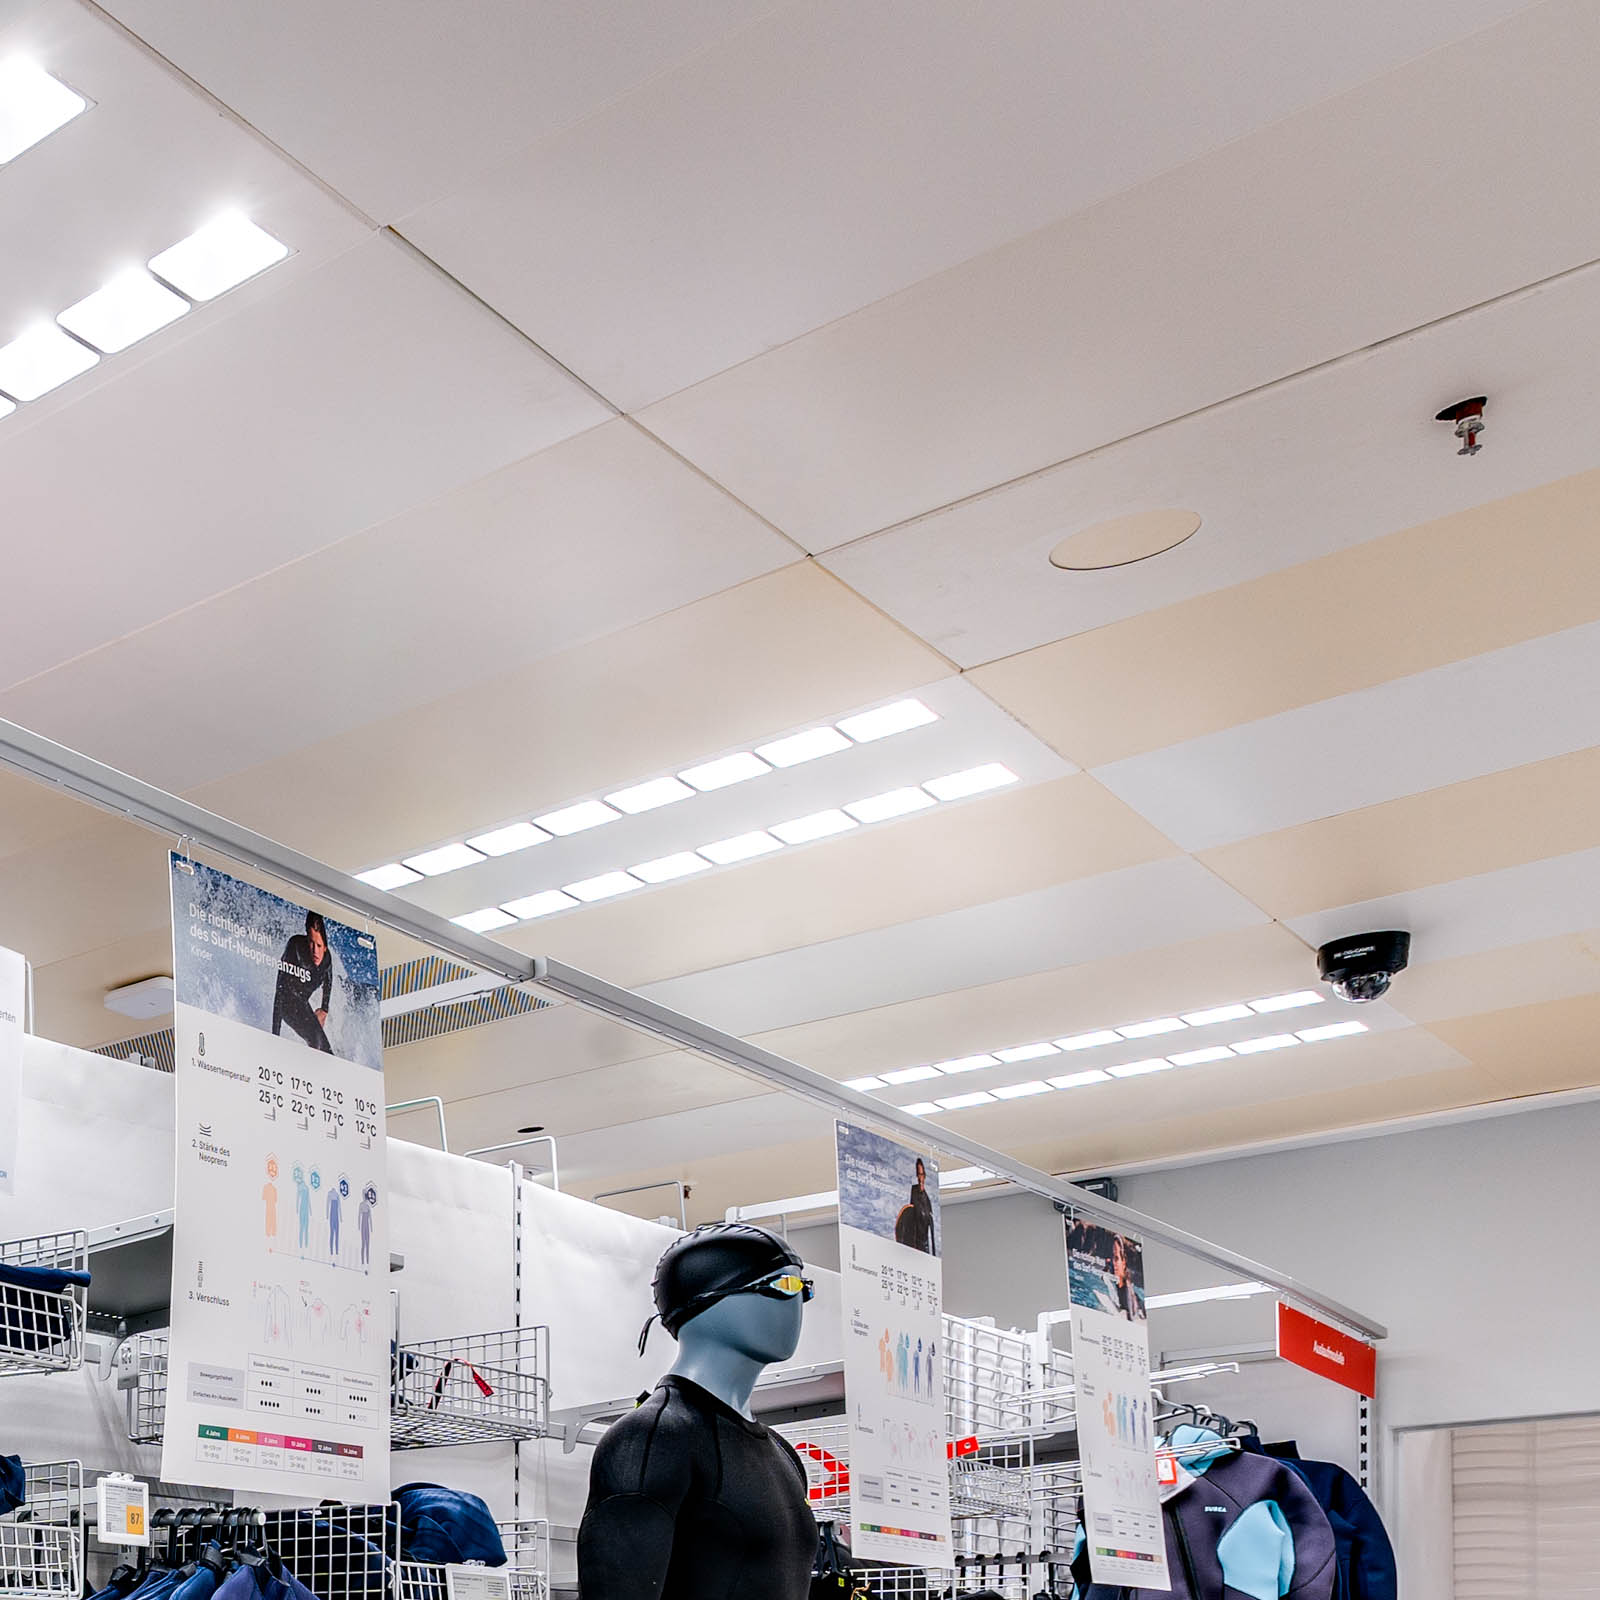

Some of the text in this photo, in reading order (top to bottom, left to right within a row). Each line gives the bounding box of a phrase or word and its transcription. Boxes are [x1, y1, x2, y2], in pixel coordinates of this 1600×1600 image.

[189, 903, 272, 947] Die richtige Wahl
[190, 924, 311, 983] des Surf-Neoprenanzugs
[197, 1060, 251, 1083] Wassertemperatur
[258, 1066, 270, 1081] 20
[291, 1077, 300, 1090] 17
[322, 1087, 332, 1101] 12
[355, 1098, 365, 1112] 10
[259, 1089, 270, 1104] 25
[291, 1100, 303, 1114] 22
[322, 1109, 332, 1122] 17
[356, 1120, 365, 1134] 12
[199, 1140, 218, 1155] Stärke
[219, 1146, 230, 1157] des
[199, 1153, 228, 1167] Neoprens
[196, 1292, 230, 1306] Verschluss
